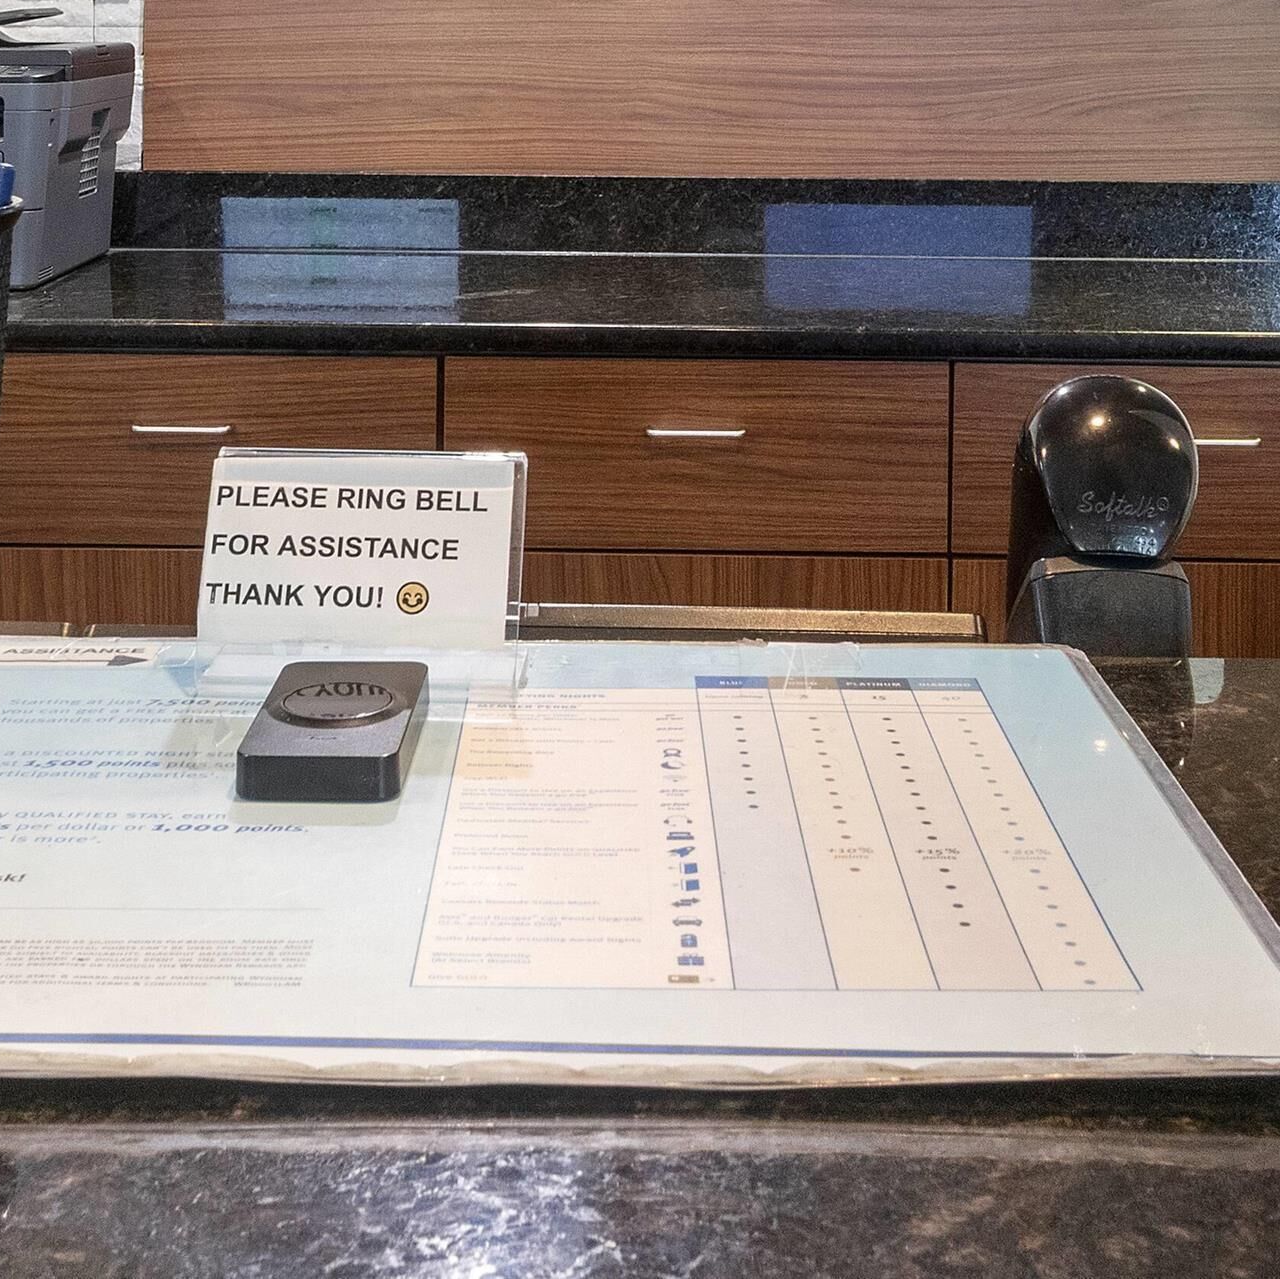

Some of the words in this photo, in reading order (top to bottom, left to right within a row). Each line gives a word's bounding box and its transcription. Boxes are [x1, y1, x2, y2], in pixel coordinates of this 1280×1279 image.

[216, 486, 328, 509] PLEASE
[337, 489, 406, 510] RING
[416, 490, 488, 512] BELL
[211, 534, 270, 556] FOR
[277, 536, 460, 560] ASSISTANCE
[206, 583, 305, 607] THANK
[314, 585, 384, 608] YOU!
[145, 699, 211, 707] 7,500
[23, 760, 94, 768] 1,500
[97, 760, 161, 768] points
[126, 812, 173, 820] STAY,
[15, 824, 52, 832] per
[57, 823, 118, 831] dollar
[151, 823, 229, 832] 1,000
[235, 823, 309, 833] points.
[10, 835, 28, 843] is
